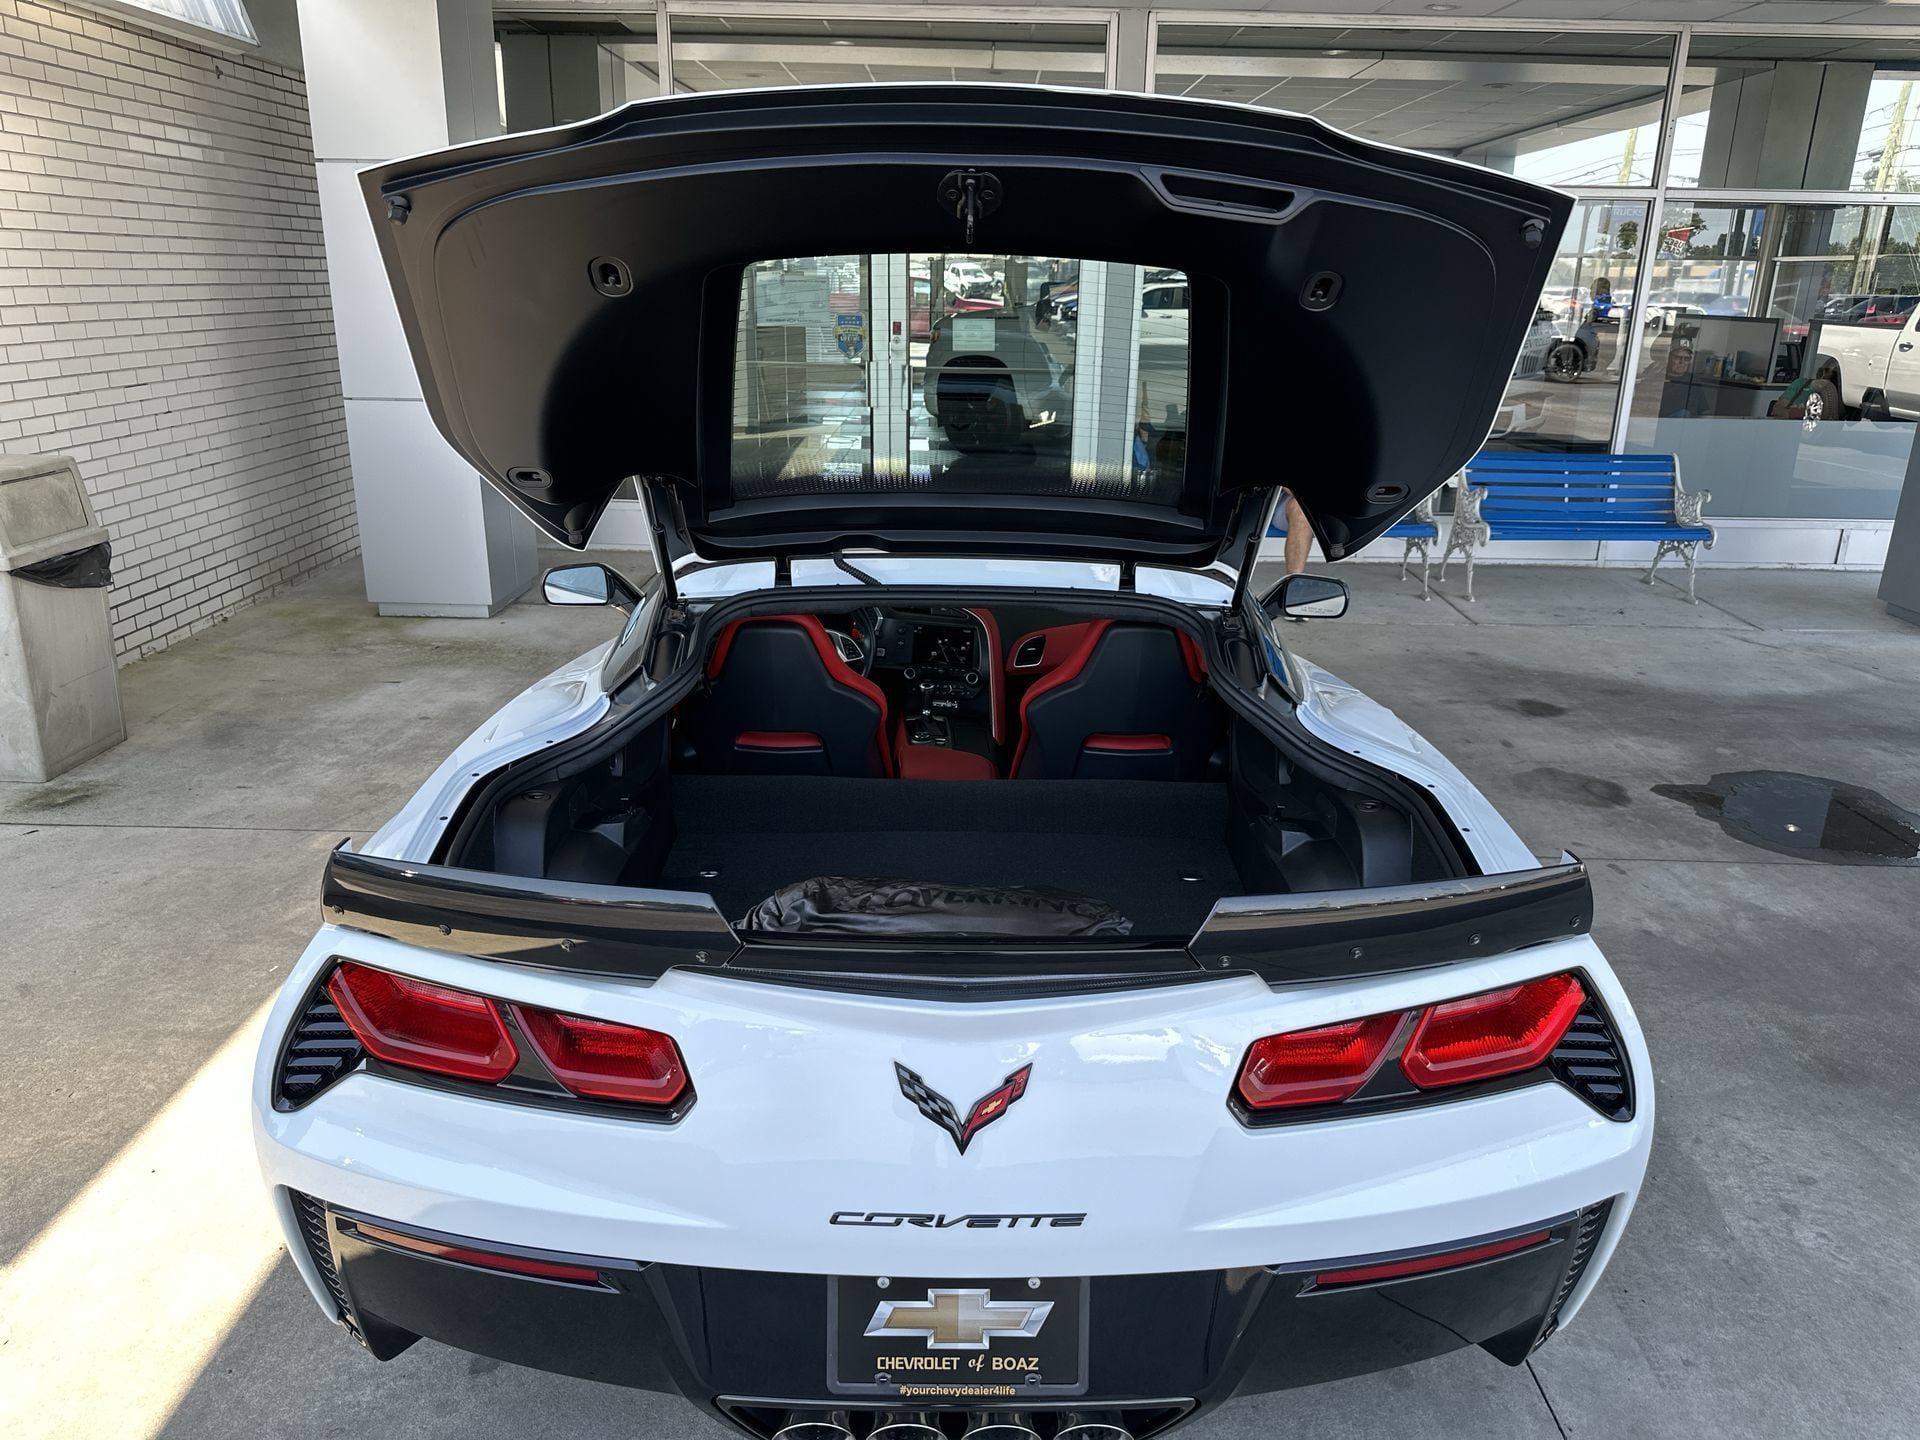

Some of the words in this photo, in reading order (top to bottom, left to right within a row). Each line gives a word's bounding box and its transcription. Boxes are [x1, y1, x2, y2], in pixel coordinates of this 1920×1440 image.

[1611, 208, 1645, 217] RUCKS
[829, 1211, 1088, 1228] CORVETTE
[877, 1356, 960, 1371] CHEVROLET
[968, 1354, 985, 1372] of
[991, 1356, 1039, 1371] BOAZ
[899, 1384, 1016, 1397] #yourchevydealer4life
